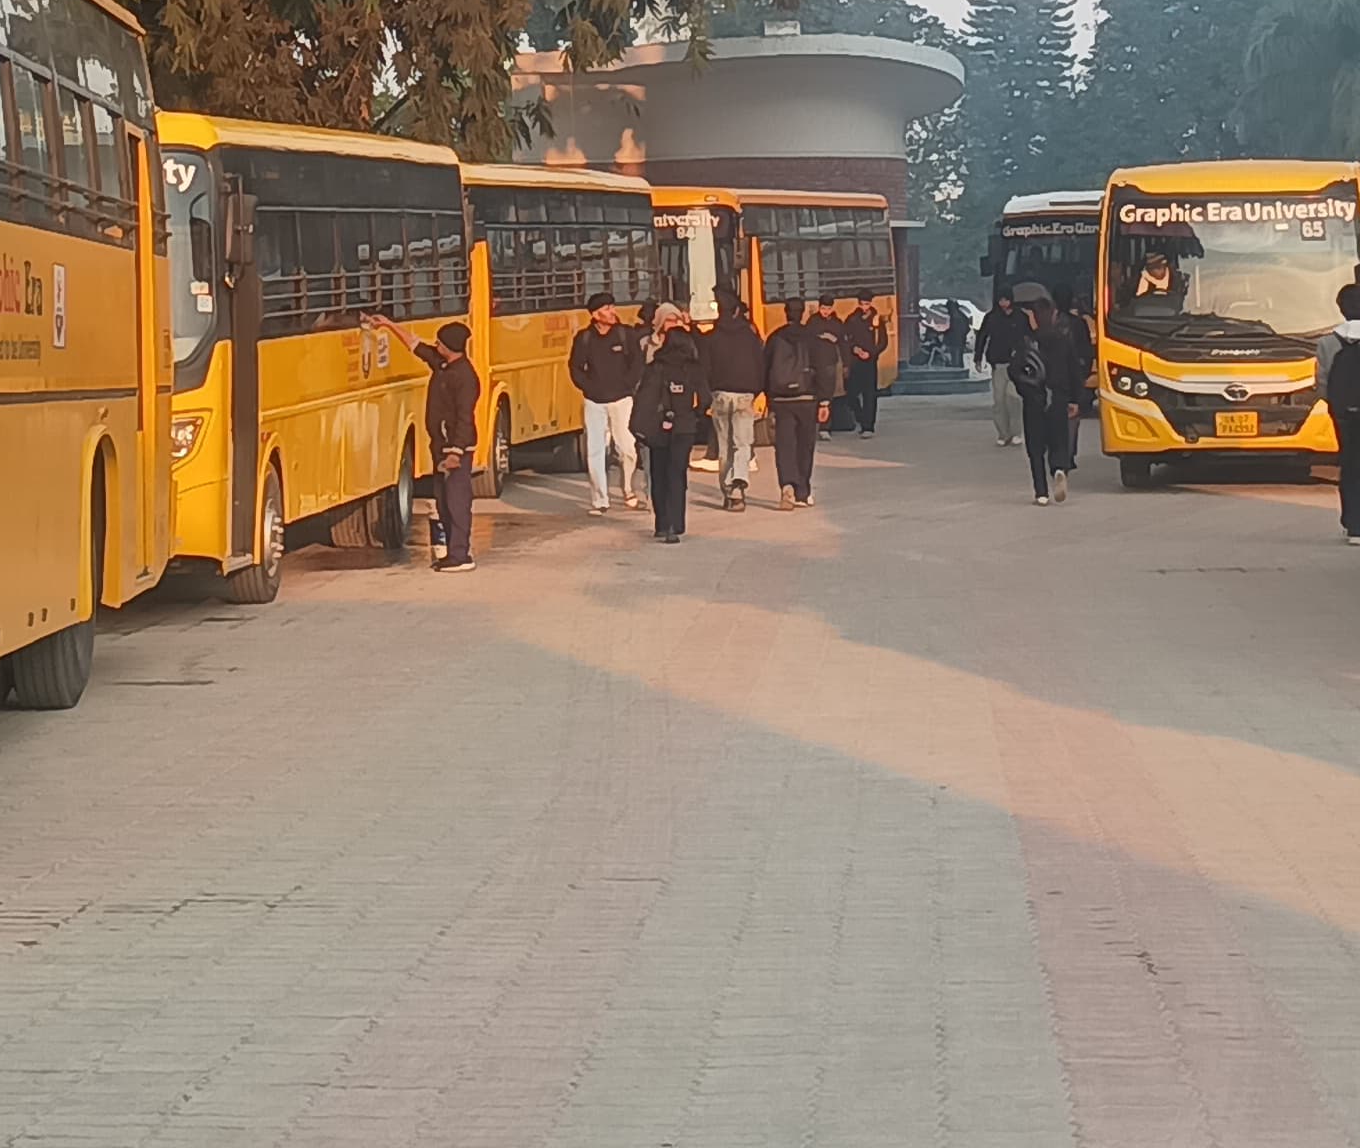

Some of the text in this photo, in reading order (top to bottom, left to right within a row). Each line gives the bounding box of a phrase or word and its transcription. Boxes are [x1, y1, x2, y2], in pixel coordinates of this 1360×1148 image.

[1119, 198, 1356, 227] Graphic Era University
[1301, 220, 1324, 238] 65
[24, 260, 43, 316] Era
